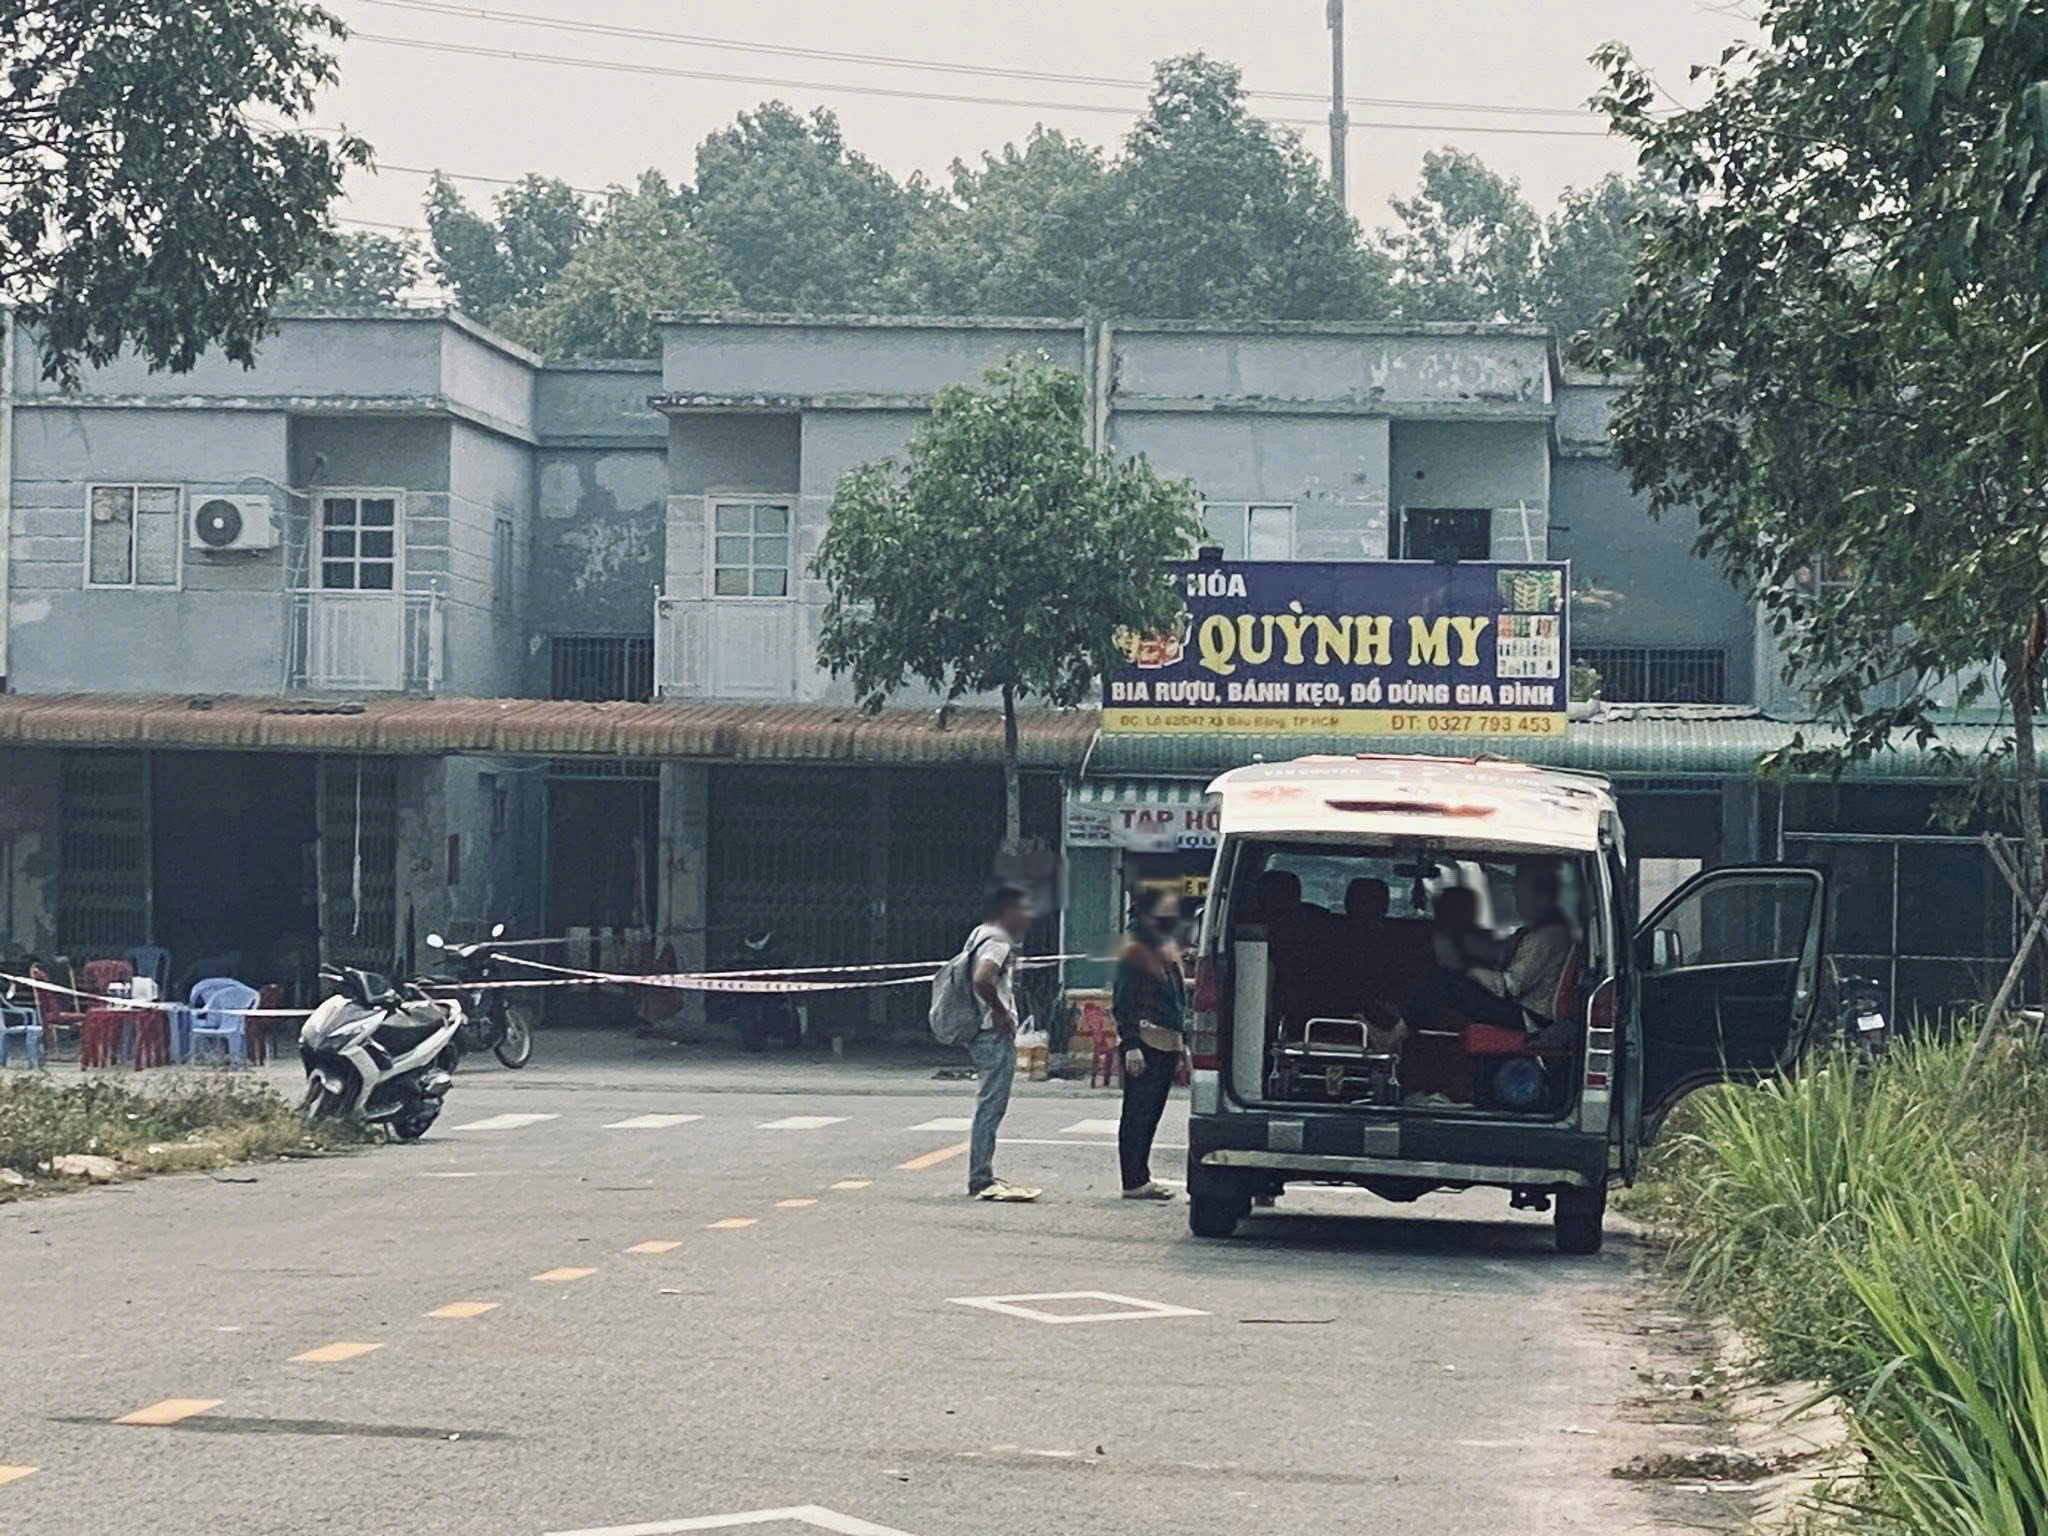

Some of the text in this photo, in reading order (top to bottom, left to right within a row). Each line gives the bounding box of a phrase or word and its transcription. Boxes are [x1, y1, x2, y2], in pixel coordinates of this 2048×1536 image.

[1187, 569, 1248, 597] HÓA
[1199, 600, 1490, 676] QUỲNH MY
[1111, 682, 1149, 701] BIA
[1155, 680, 1221, 705] RƯỢU,
[1228, 679, 1290, 703] BÁNH
[1295, 682, 1345, 706] KẸO,
[1455, 684, 1494, 706] GIA
[1499, 681, 1554, 707] ĐÌNH
[1391, 714, 1551, 733] ĐT: 0327 793 453
